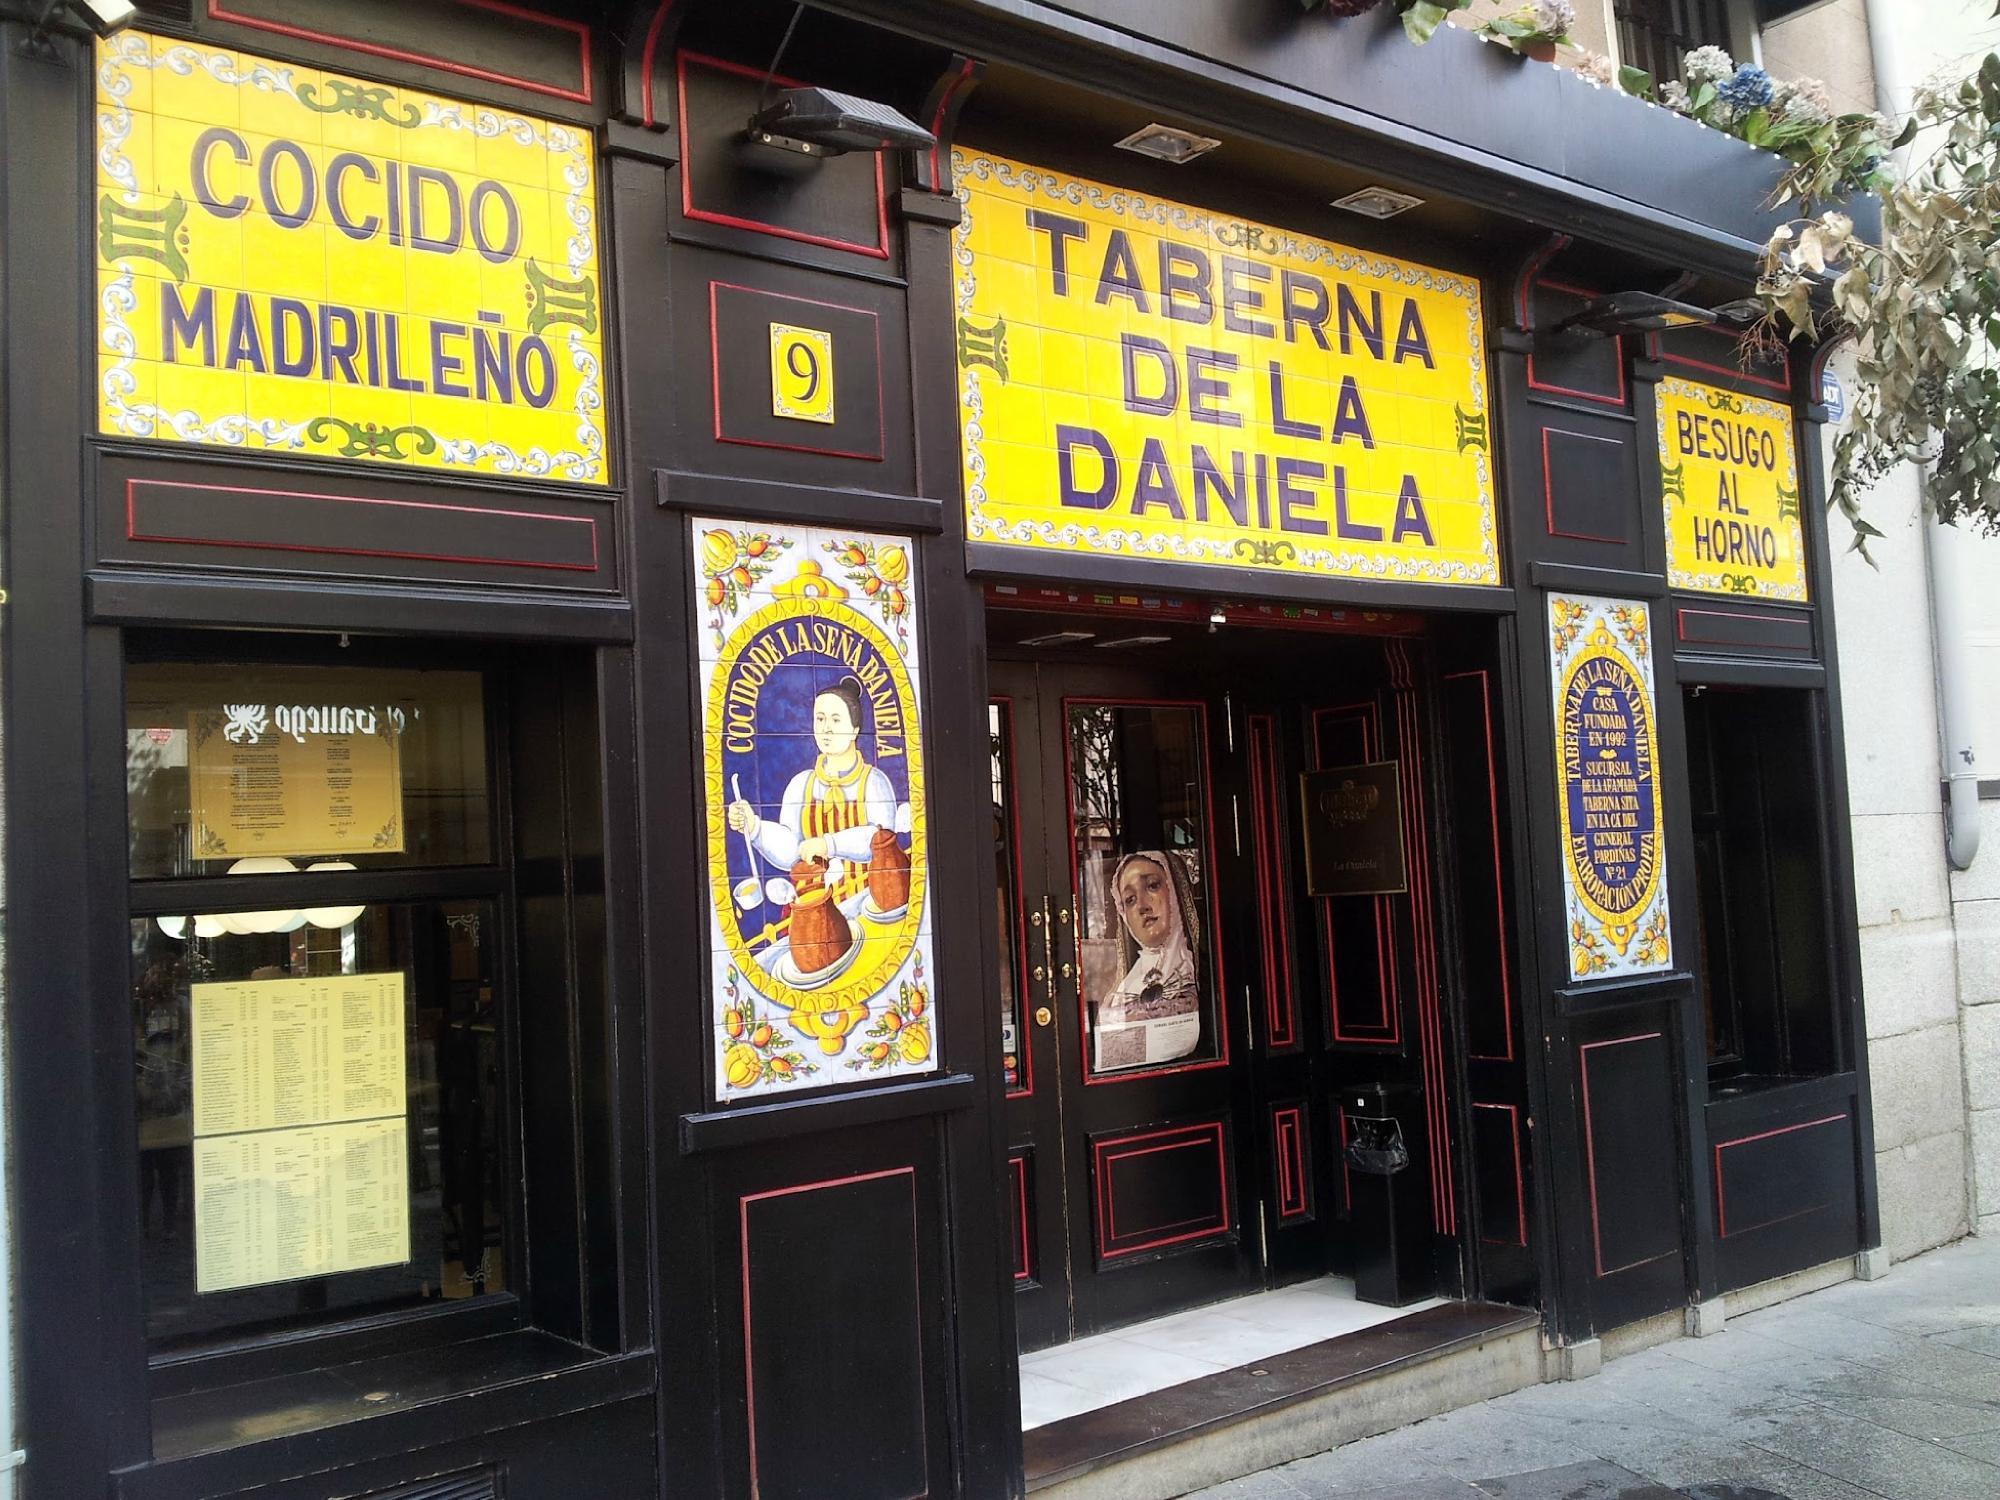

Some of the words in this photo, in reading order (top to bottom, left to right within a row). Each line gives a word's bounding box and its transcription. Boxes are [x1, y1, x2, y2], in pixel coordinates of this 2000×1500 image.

[190, 127, 523, 263] COCIDO
[1025, 207, 1437, 371] TABERNA
[162, 281, 558, 409] MADRILEÑO
[787, 342, 820, 402] 9
[1121, 332, 1243, 429] DE
[1270, 360, 1375, 449] LA
[1676, 410, 1776, 472] BESUGO
[1056, 424, 1435, 546] DANIELA
[1718, 470, 1749, 516] AL
[1693, 515, 1777, 570] HORNO
[726, 664, 756, 754] COCIDO
[749, 634, 784, 676] DE
[776, 622, 813, 657] LA
[857, 653, 903, 758] DANIELA
[1572, 671, 1591, 697] DE
[1587, 660, 1604, 685] LA
[1583, 714, 1627, 729] FUNDADA
[1592, 697, 1618, 711] CASA
[1566, 693, 1583, 783] TABERNA
[1589, 731, 1602, 746] EN
[1605, 731, 1627, 746] 1992
[1628, 697, 1651, 782] DANIELA
[1586, 761, 1632, 777] SUCURSAL
[1592, 779, 1602, 793] LA
[1583, 796, 1620, 812] TABERNA
[1621, 796, 1639, 810] SITA
[1586, 813, 1598, 829] EN
[1599, 813, 1610, 828] LA
[1594, 831, 1633, 847] GENERAL
[1594, 847, 1636, 864] PARDIÑAS
[1572, 835, 1635, 910] ELABORACIÓN
[1631, 833, 1654, 898] PROPIA
[1616, 866, 1626, 880] 21
